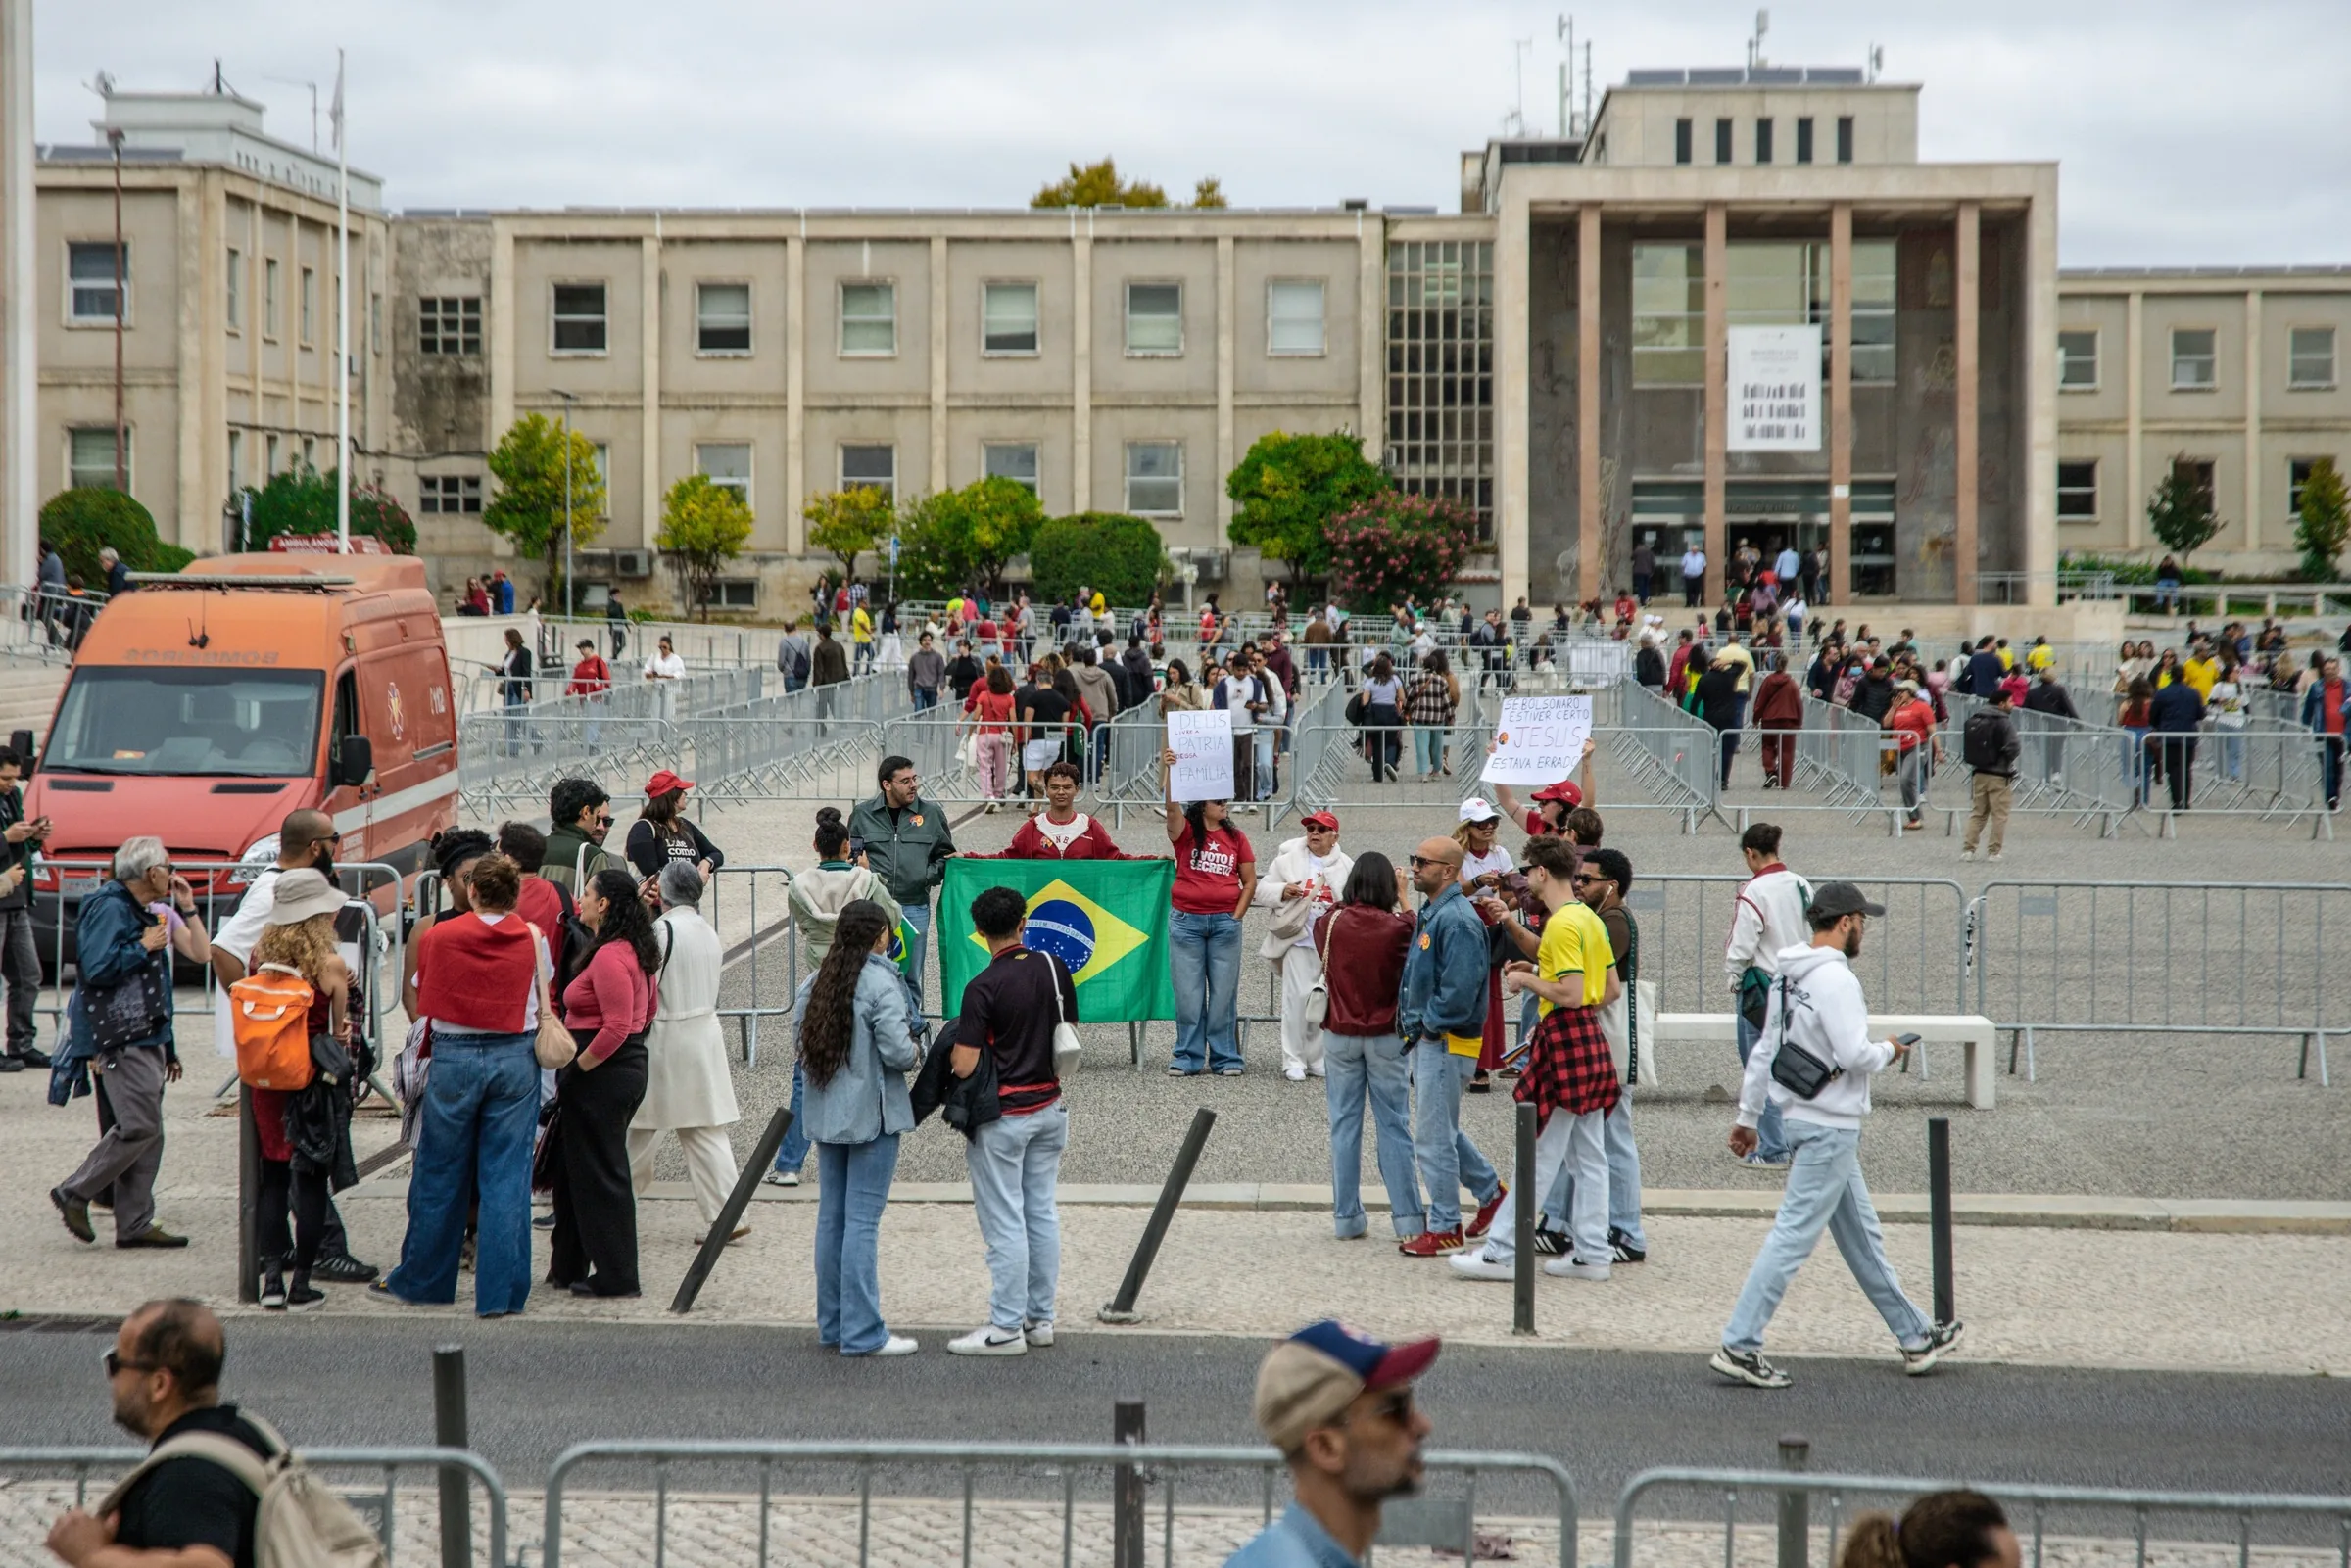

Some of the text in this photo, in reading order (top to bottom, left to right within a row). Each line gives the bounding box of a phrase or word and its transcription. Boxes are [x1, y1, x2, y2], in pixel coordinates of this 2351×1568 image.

[1504, 697, 1580, 710] SE BOLSONARO
[1179, 713, 1227, 729] DEUS
[1509, 709, 1590, 722] ESTIVER CERTO
[1513, 726, 1582, 748] JESUS
[1491, 757, 1532, 770] ESTAVA
[667, 847, 696, 856] como
[1200, 850, 1228, 865] VOTO
[1229, 853, 1235, 867] É
[1189, 859, 1233, 877] SECRETO
[1056, 925, 1095, 948] PROGRESSO
